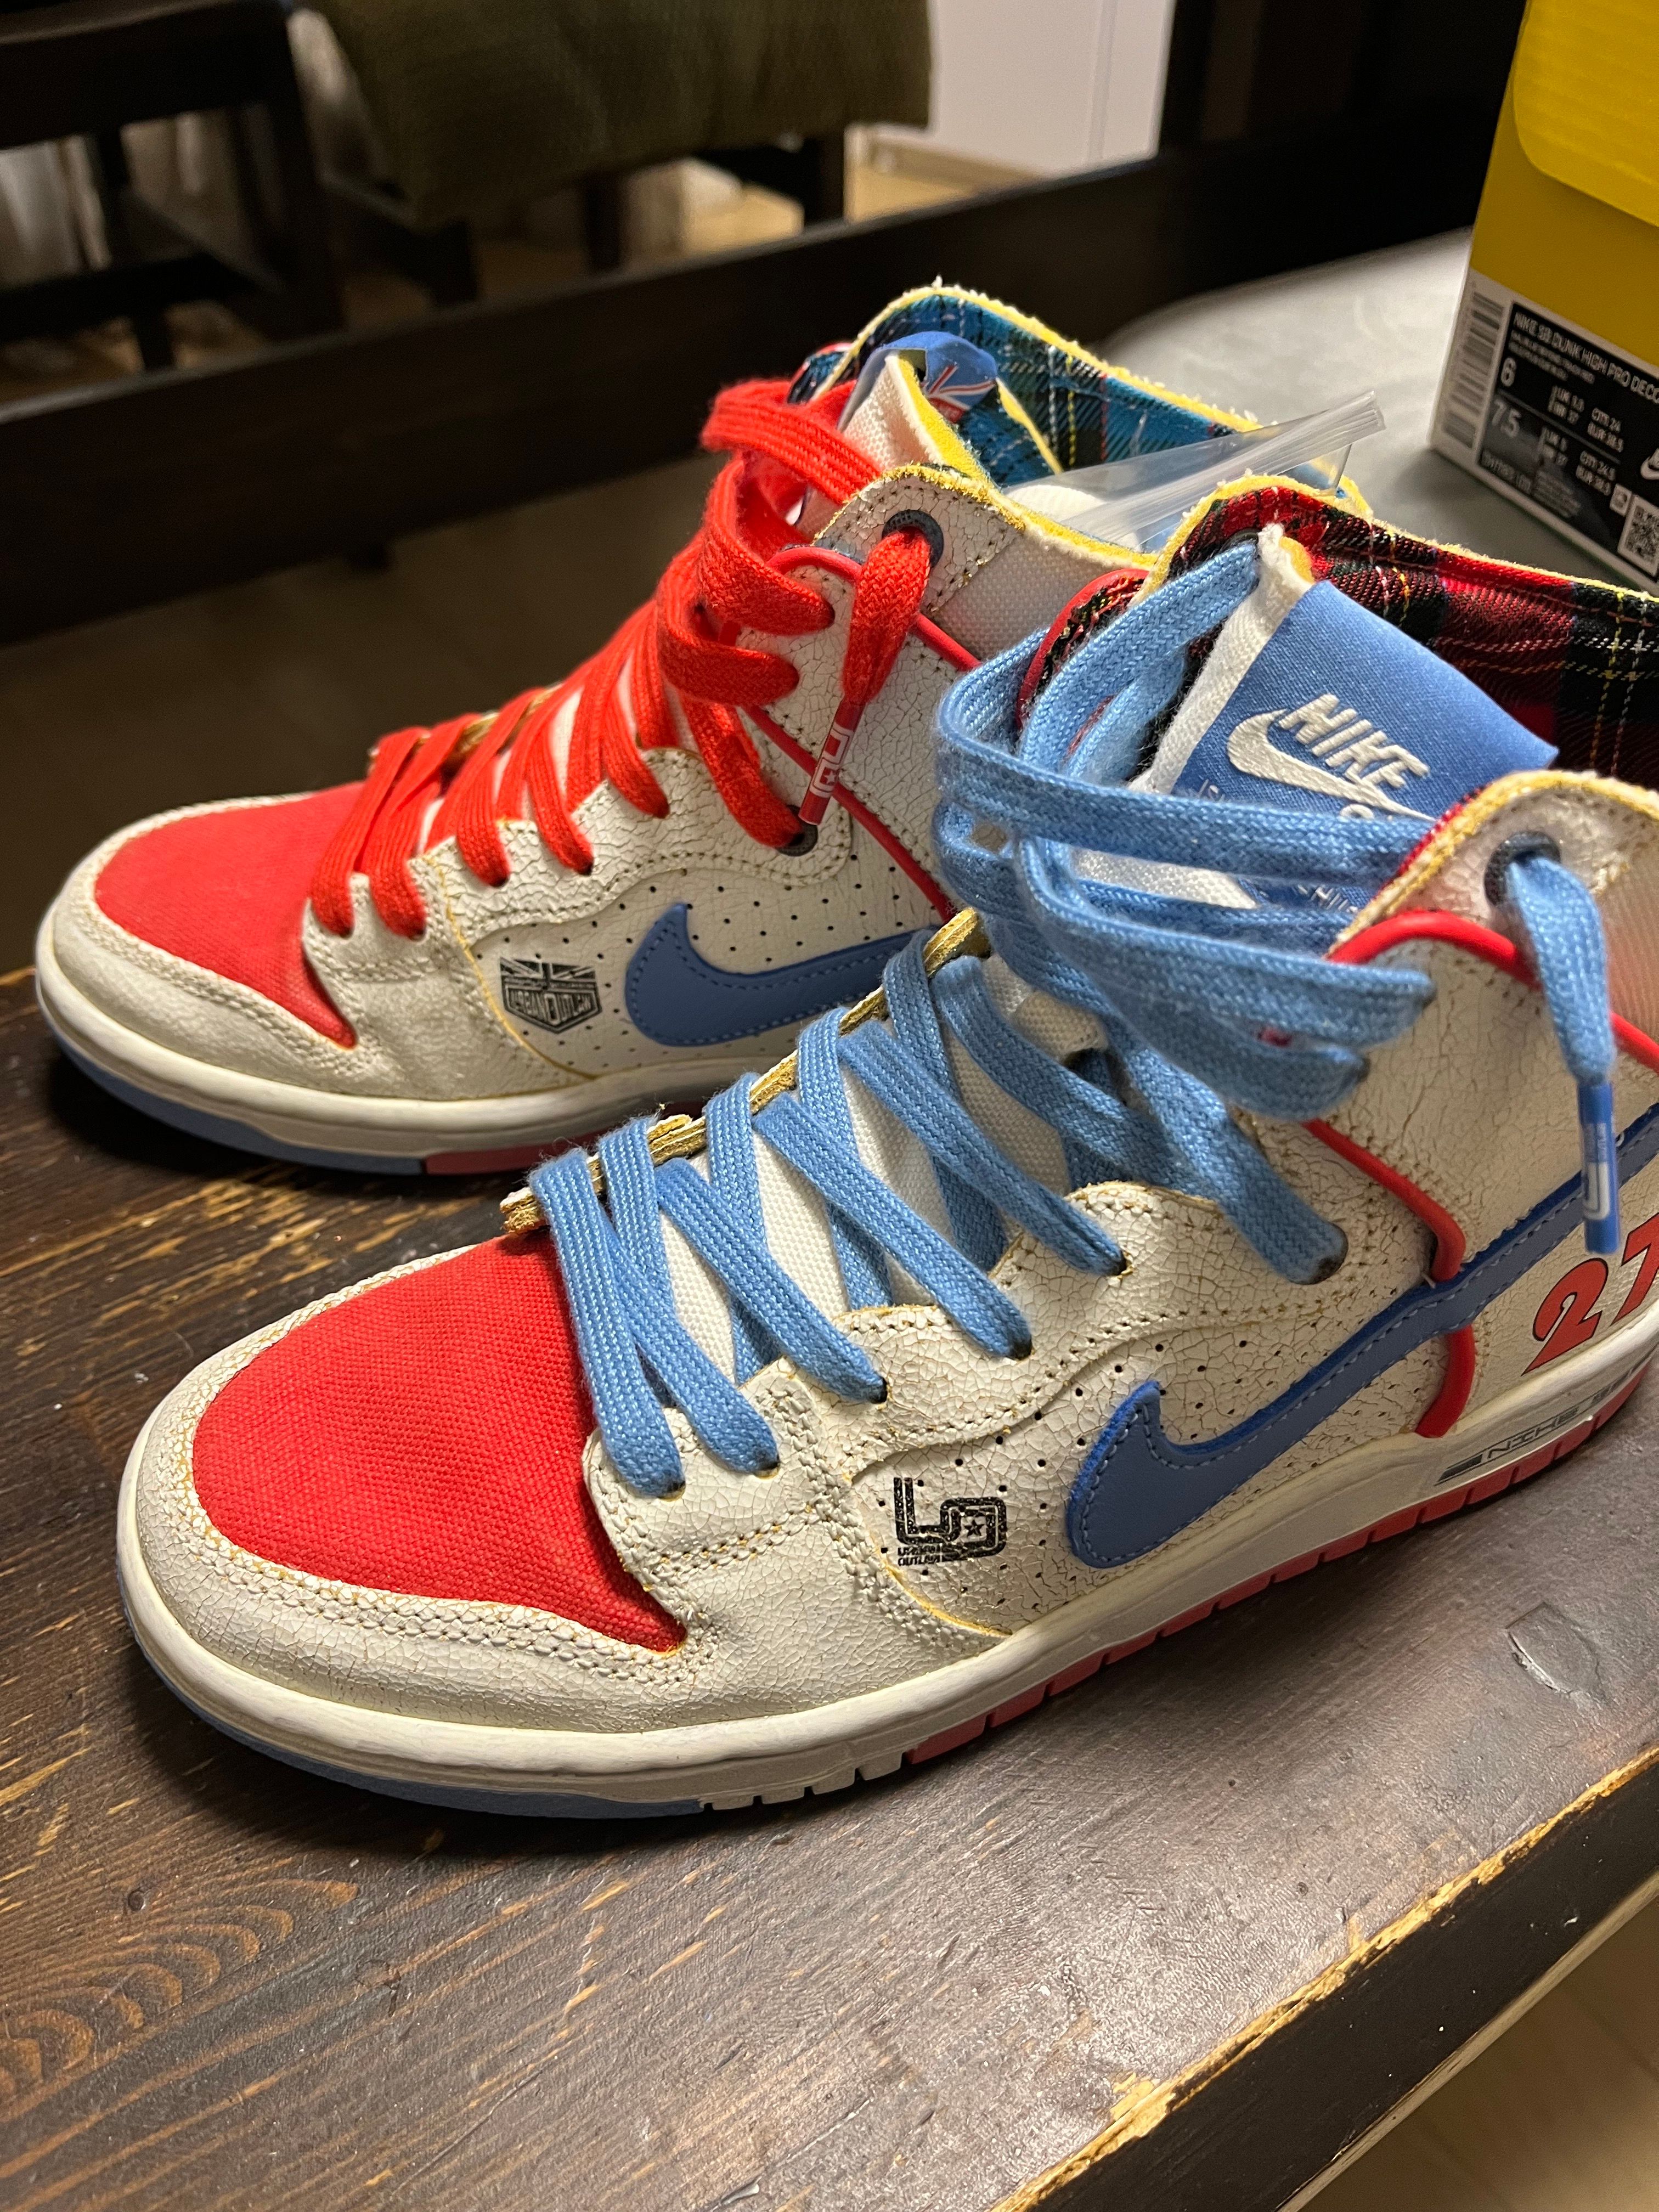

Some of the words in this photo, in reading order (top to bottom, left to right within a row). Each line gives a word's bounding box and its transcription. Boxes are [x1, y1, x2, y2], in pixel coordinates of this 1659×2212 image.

[1500, 357, 1517, 387] 6
[1513, 312, 1538, 336] NIKE
[1551, 331, 1583, 360] DUNK
[1580, 347, 1609, 375] HIGH
[1607, 362, 1632, 388] PRO
[1278, 693, 1431, 790] NIKE
